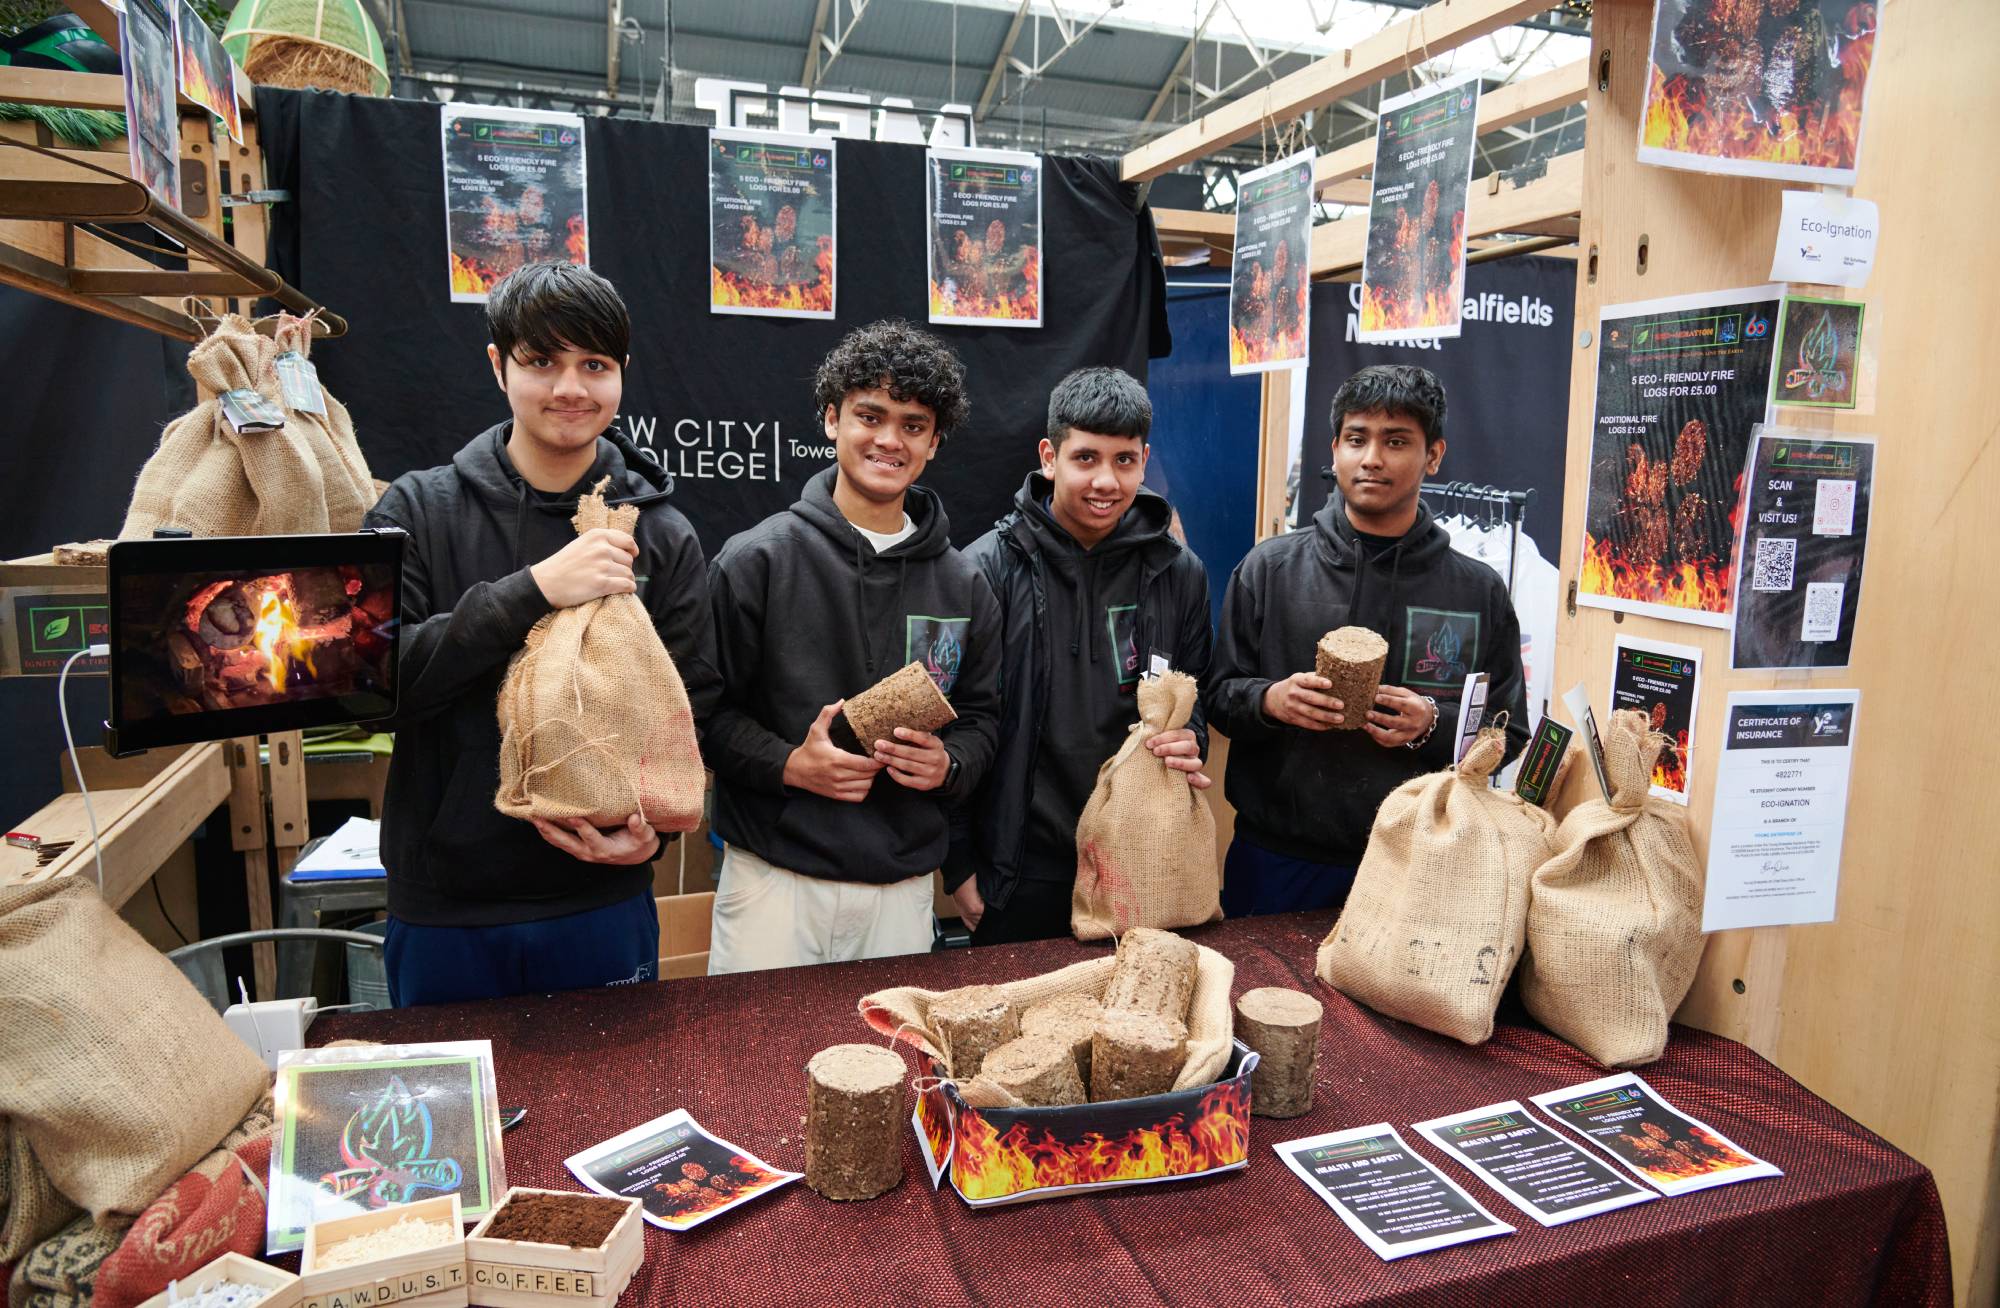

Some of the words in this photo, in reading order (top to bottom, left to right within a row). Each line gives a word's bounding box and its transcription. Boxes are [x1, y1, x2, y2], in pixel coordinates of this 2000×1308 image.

[1801, 218, 1872, 239] Eco-Ignation
[1463, 292, 1554, 327] alfields
[1632, 376, 1637, 385] 5
[1639, 374, 1656, 384] ECO
[1664, 372, 1710, 384] FRIENDLY
[1711, 370, 1735, 380] FIRE
[1644, 388, 1668, 398] LOGS
[1670, 386, 1689, 396] FOR
[674, 418, 765, 450] CITY
[788, 439, 836, 460] Towe
[1768, 480, 1792, 490] SCAN
[1776, 497, 1782, 506] &
[1758, 513, 1780, 522] VISIT
[1782, 514, 1798, 523] US!
[1738, 718, 1789, 727] CERTIFICATE
[1790, 717, 1802, 726] OF
[1736, 730, 1782, 740] INSURANCE
[1761, 799, 1810, 808] ECO-IGNATION
[1458, 1136, 1489, 1148] HEALTH
[1490, 1132, 1508, 1142] AND
[1509, 1128, 1538, 1140] SAFETY
[1315, 1162, 1350, 1174] HEALTH
[1352, 1160, 1370, 1168] AND
[1371, 1153, 1404, 1166] SAFETY
[475, 1270, 590, 1293] COFFEE
